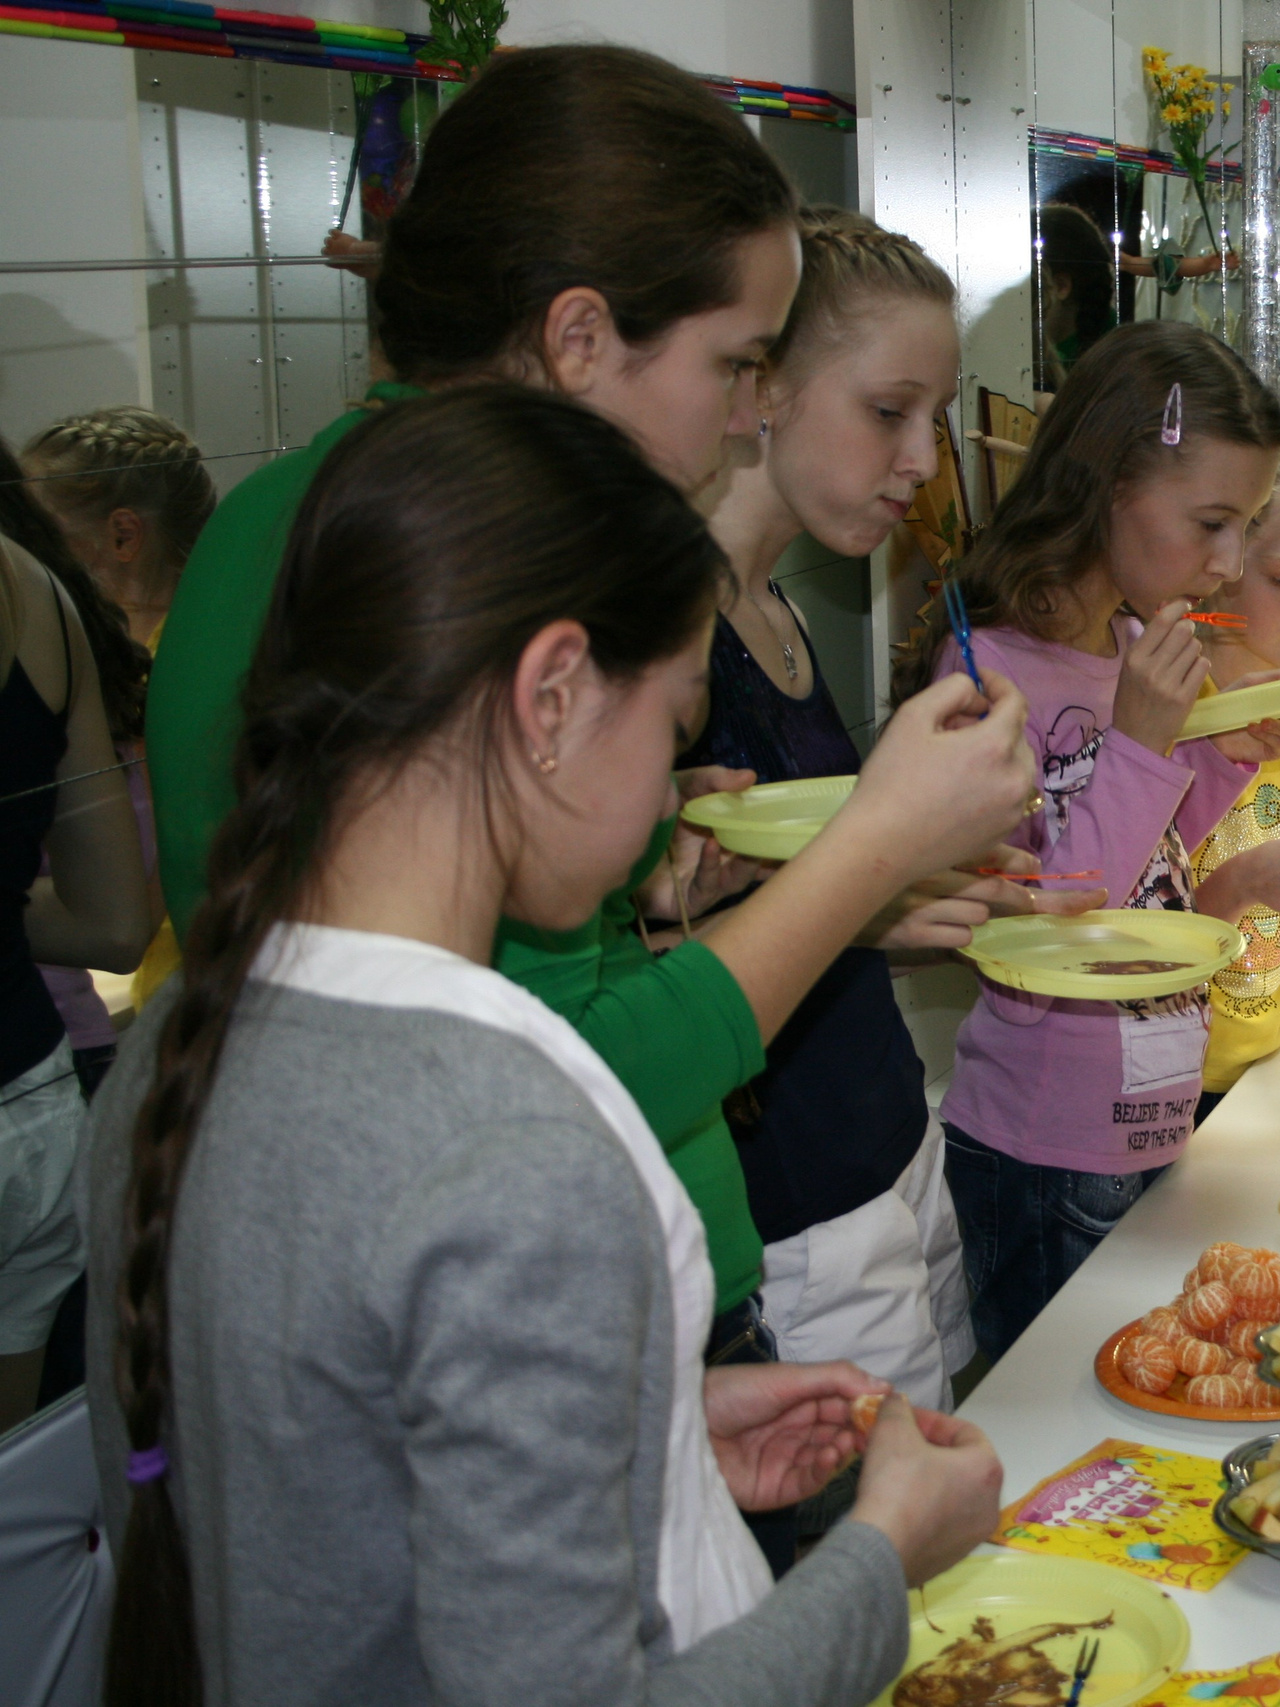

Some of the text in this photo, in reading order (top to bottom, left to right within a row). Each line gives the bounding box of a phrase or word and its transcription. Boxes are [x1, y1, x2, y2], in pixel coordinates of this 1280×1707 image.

[1112, 1101, 1160, 1123] BELIEVE
[1128, 1130, 1149, 1151] KEEP
[1151, 1128, 1167, 1149] THE
